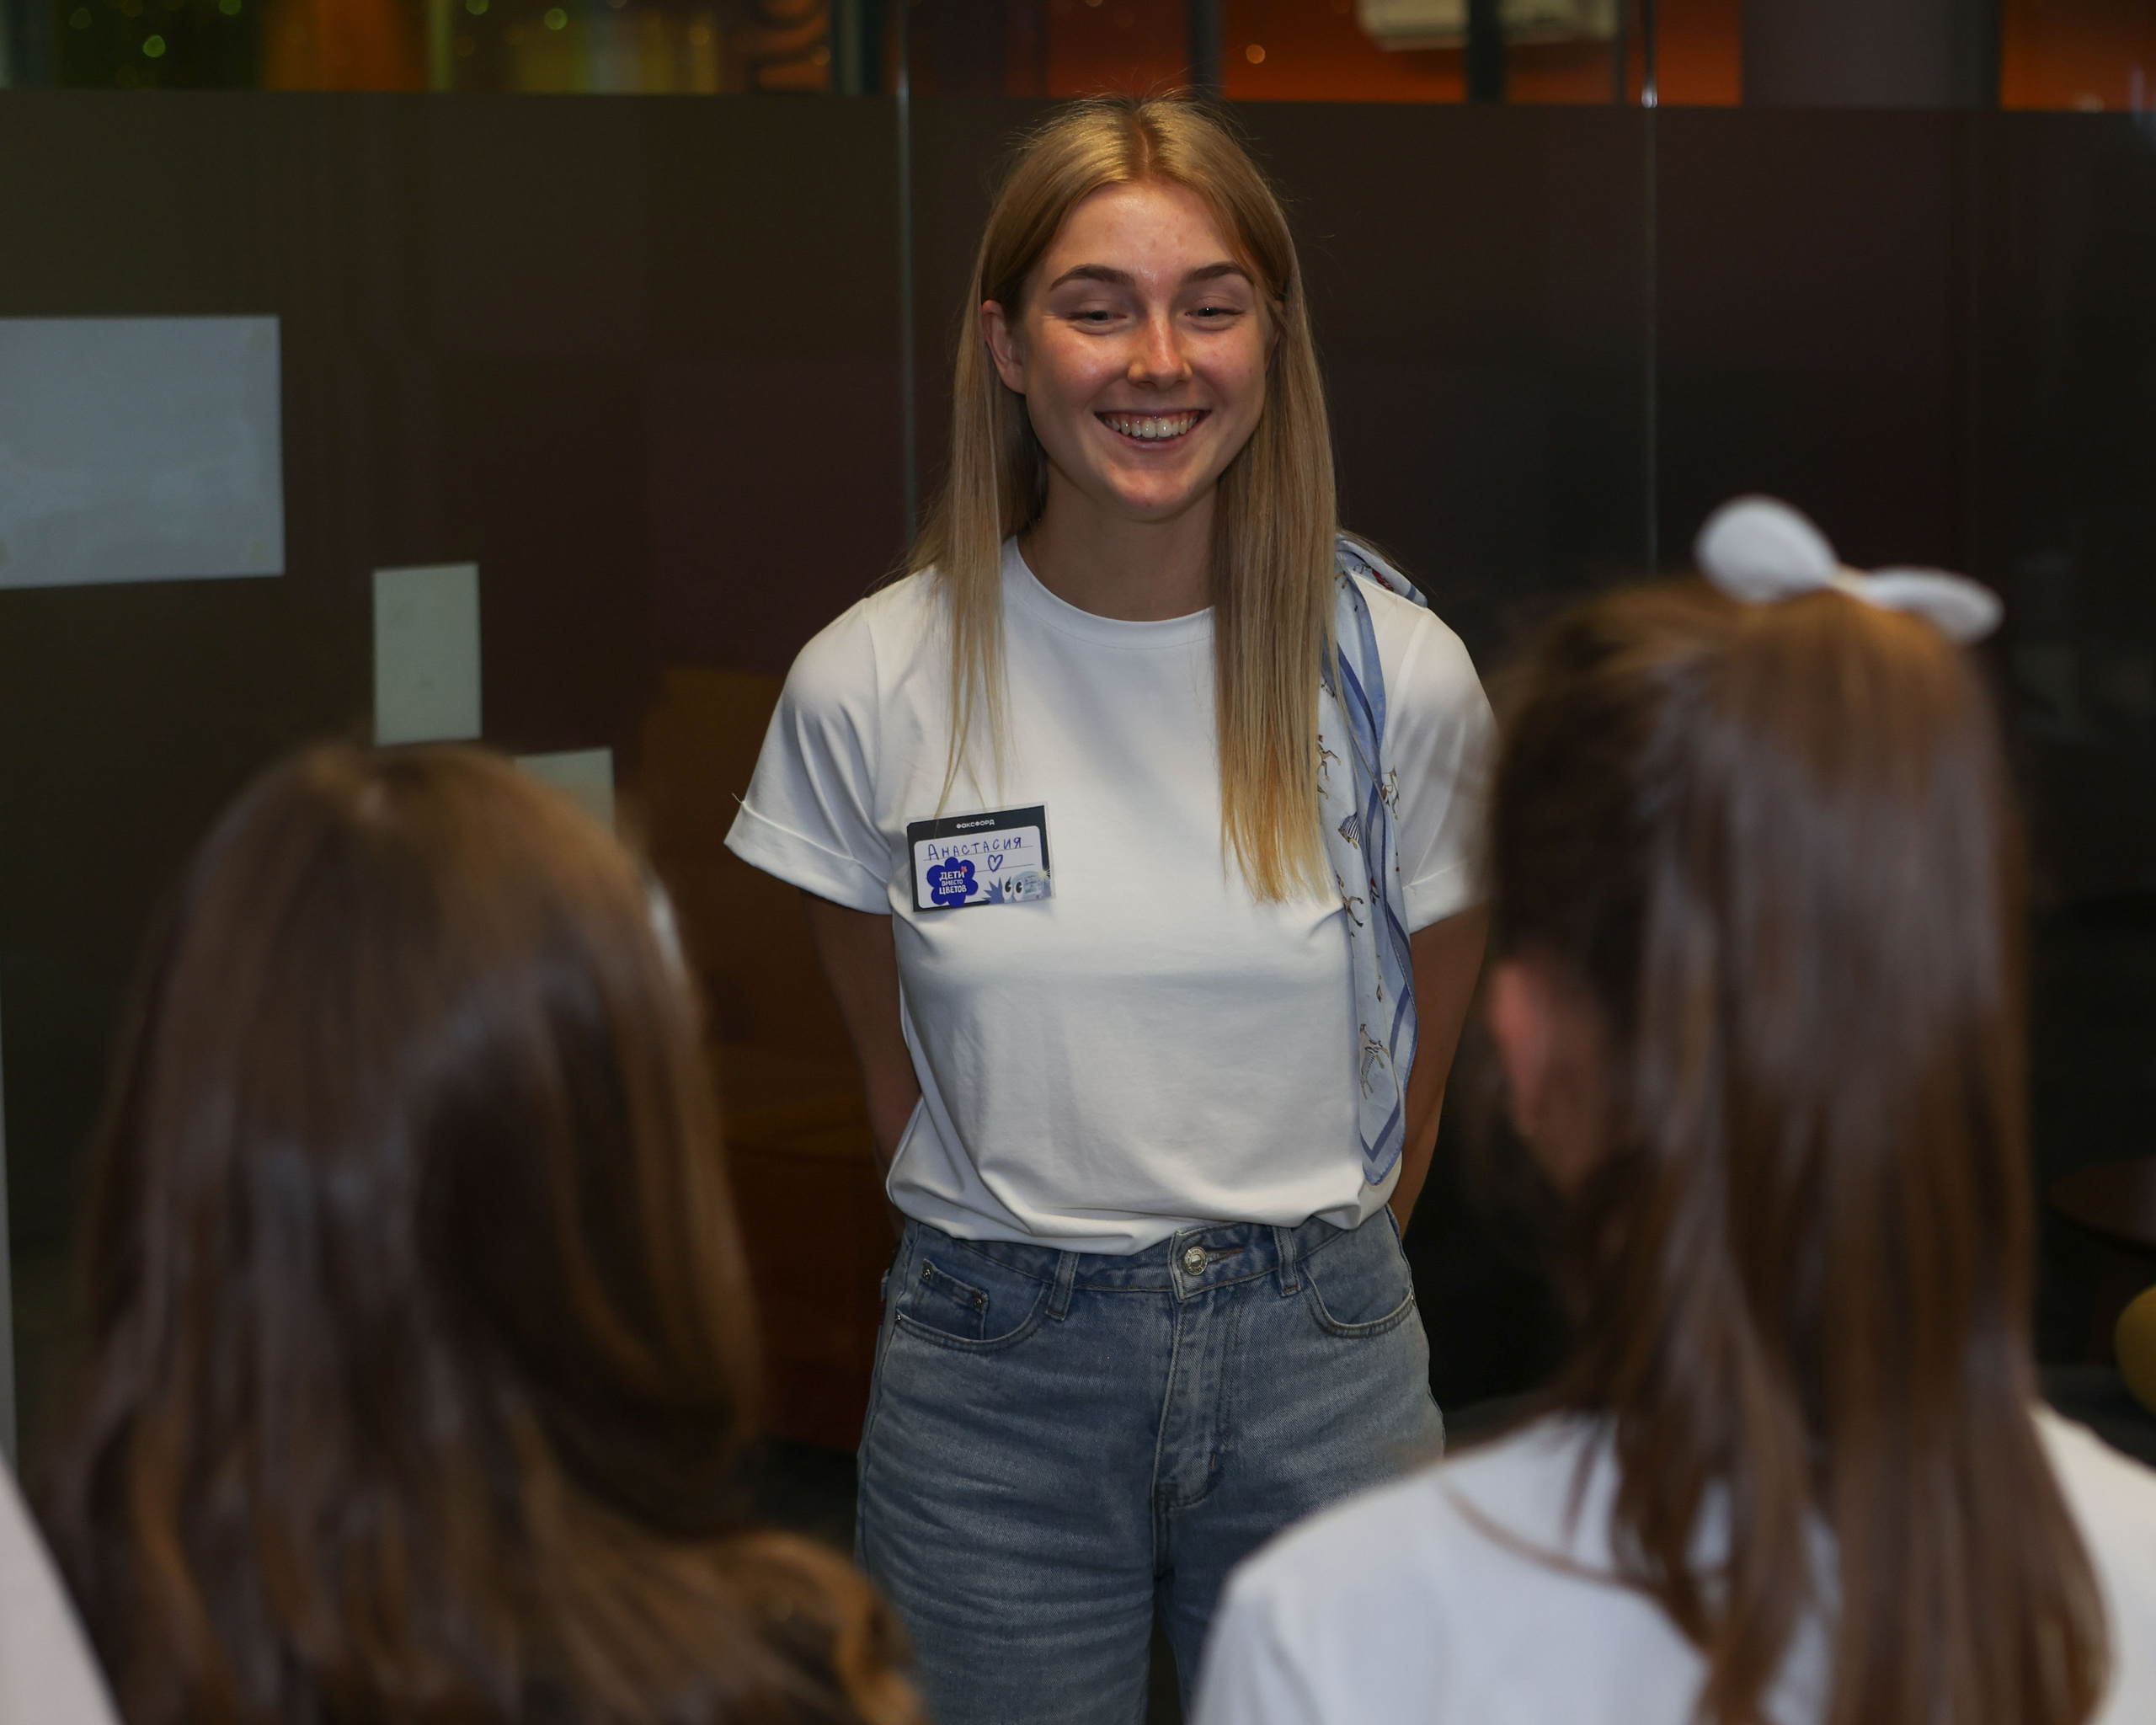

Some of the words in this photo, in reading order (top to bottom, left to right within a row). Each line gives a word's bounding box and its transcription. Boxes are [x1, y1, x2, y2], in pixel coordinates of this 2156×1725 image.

[956, 819, 995, 830] ФОКСФОРД
[939, 870, 965, 881] ДЕТИ
[939, 884, 967, 895] ЦВЕТОВ
